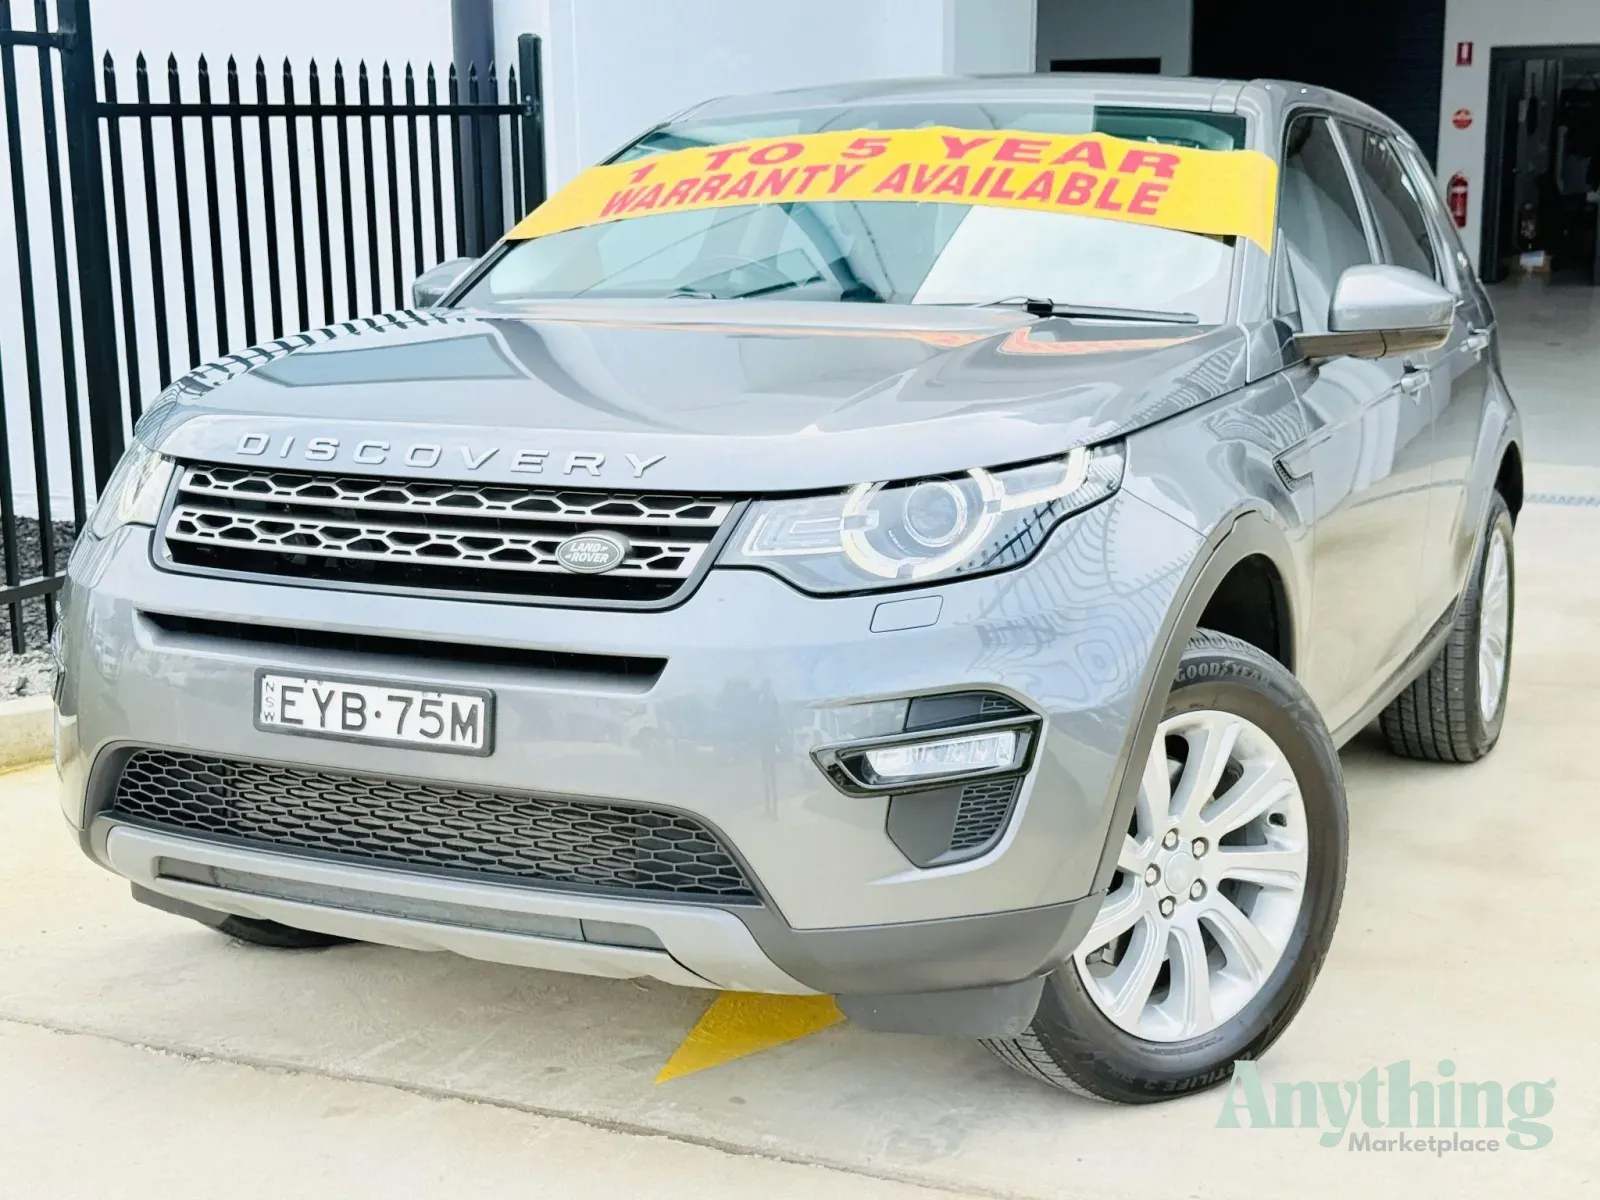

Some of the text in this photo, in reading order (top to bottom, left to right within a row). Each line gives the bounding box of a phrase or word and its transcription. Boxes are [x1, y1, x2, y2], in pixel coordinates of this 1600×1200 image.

[630, 135, 1181, 184] 1 TO 5 YEAR
[599, 163, 1170, 218] WARRANTY AVAILABLE
[235, 432, 667, 478] DISCOVERY
[570, 542, 602, 553] LAND
[570, 552, 610, 563] ROVER
